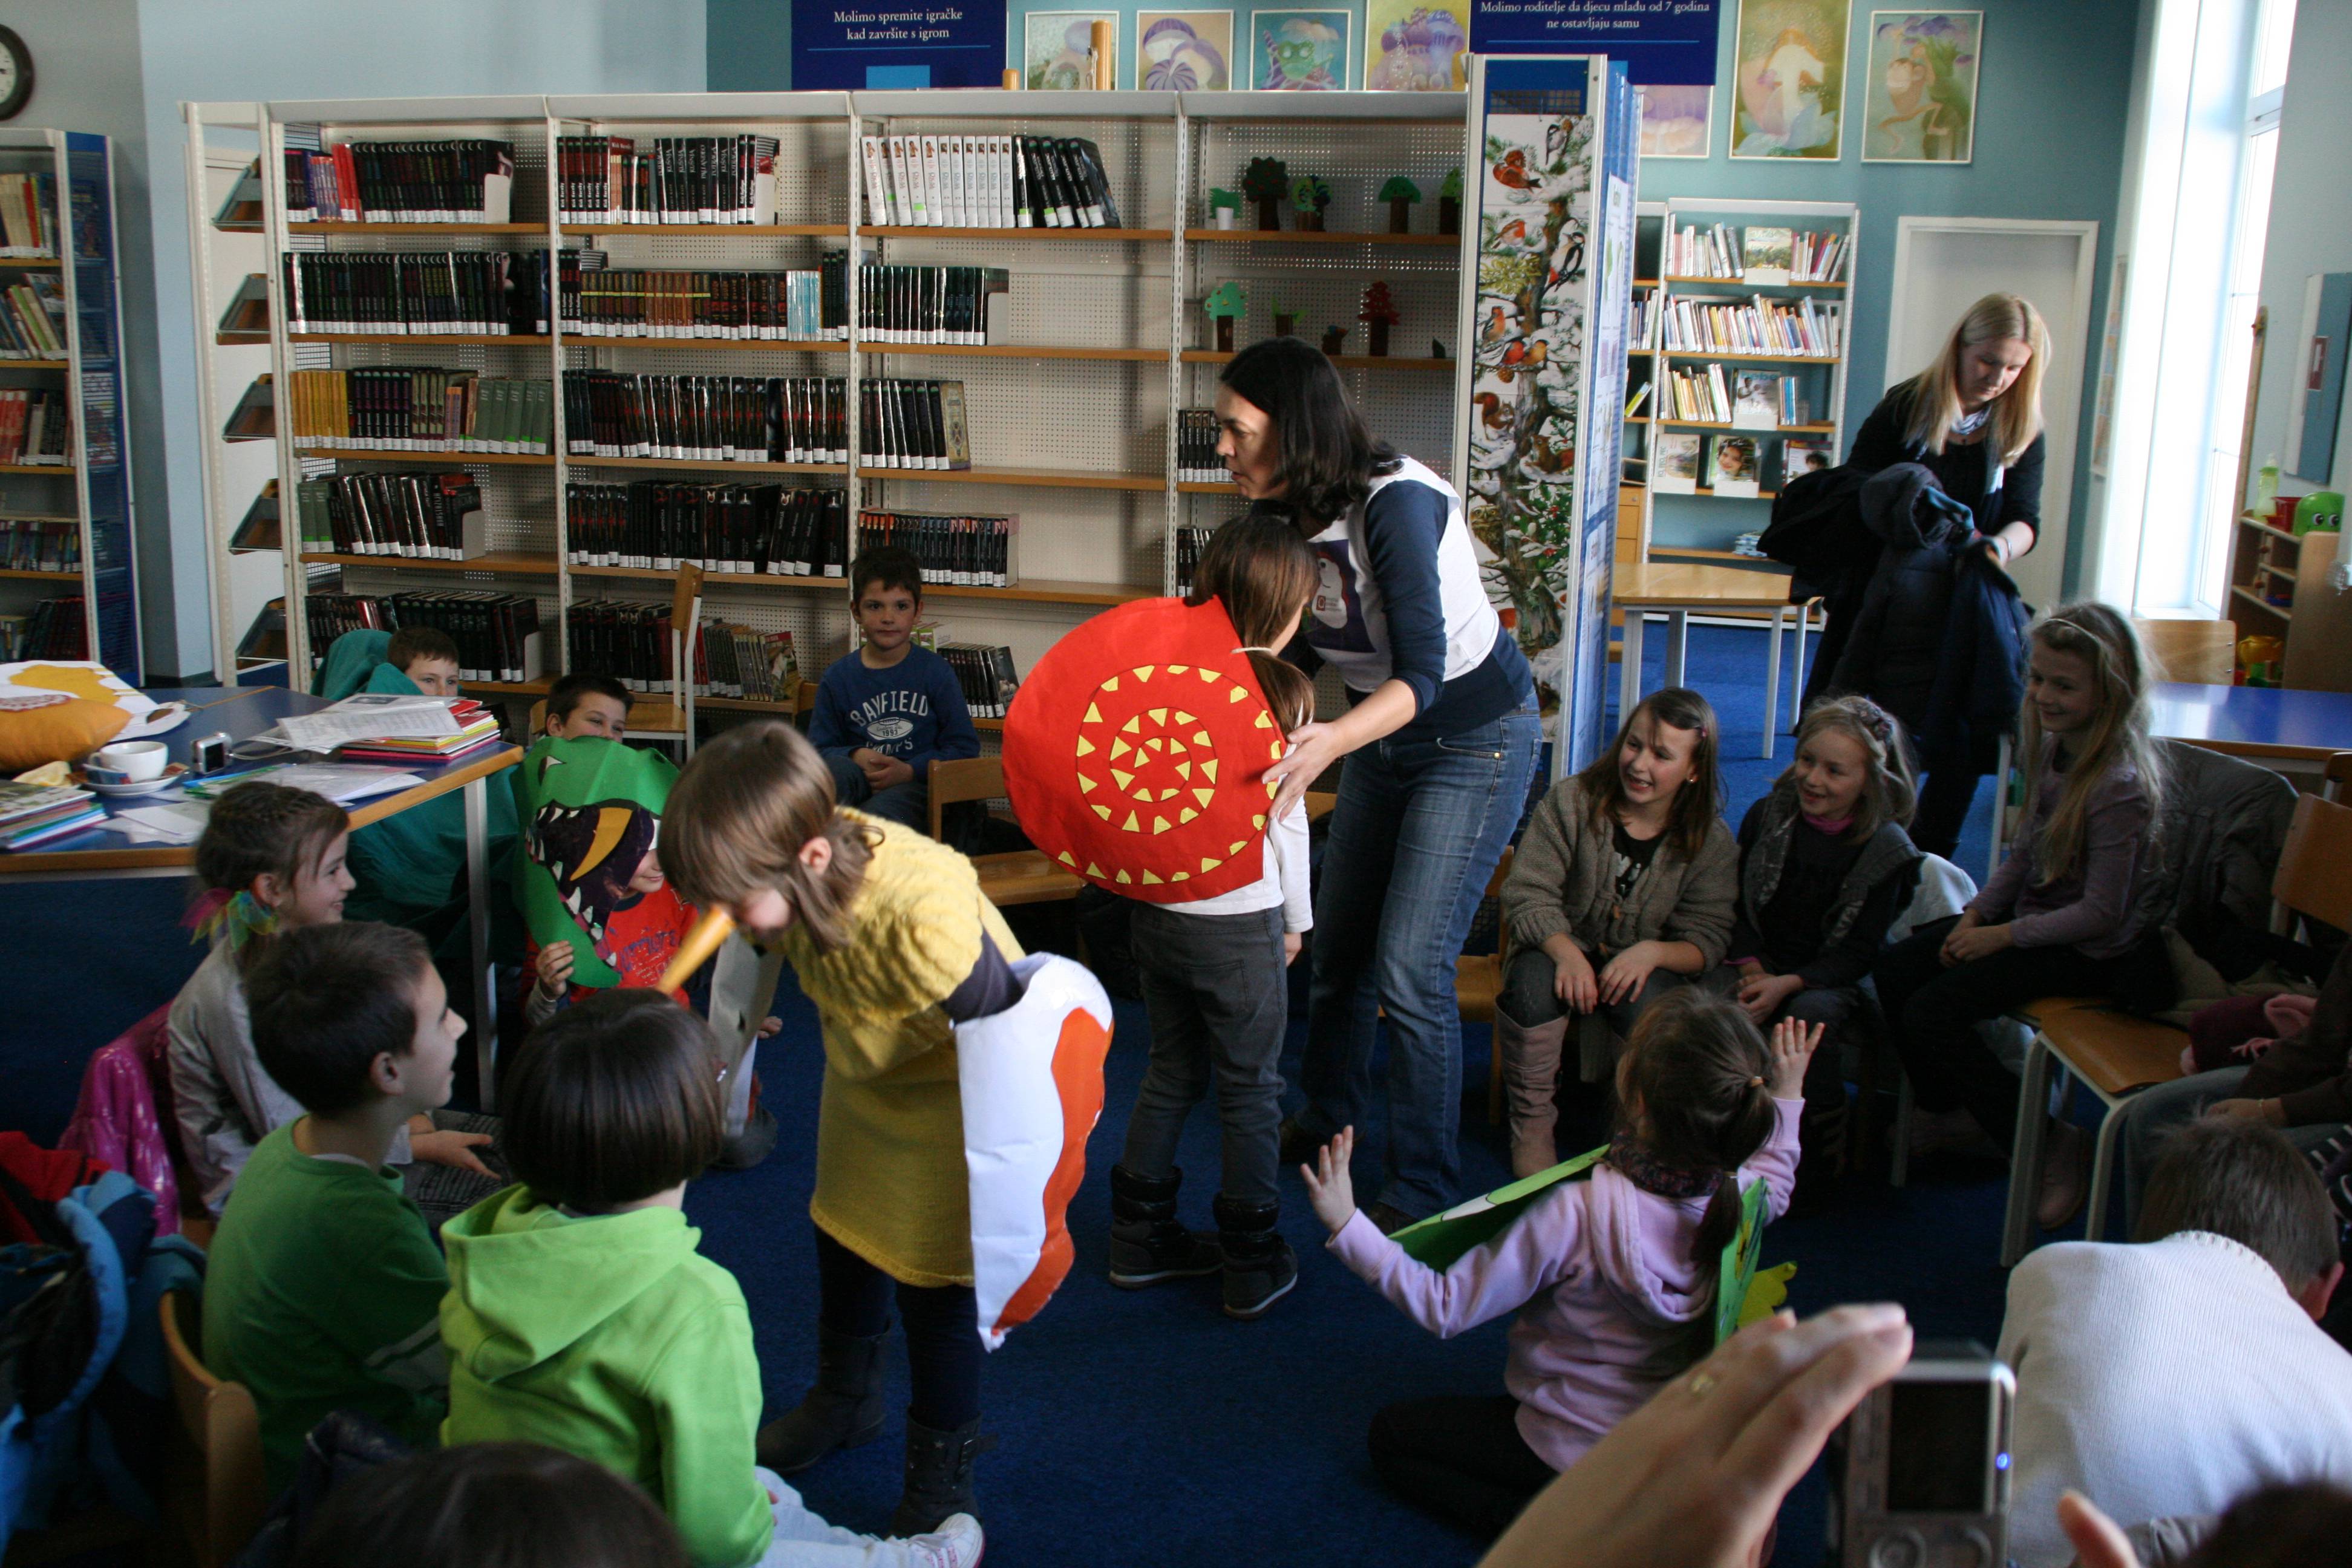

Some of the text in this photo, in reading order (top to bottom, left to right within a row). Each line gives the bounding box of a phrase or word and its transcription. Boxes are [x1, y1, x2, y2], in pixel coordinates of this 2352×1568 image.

[1480, 1, 1521, 12] Molimo
[1524, 1, 1566, 14] roditelje
[1569, 1, 1581, 11] da
[1583, 1, 1611, 14] djecu
[1649, 1, 1664, 11] od
[1665, 1, 1673, 11] 7
[1674, 1, 1710, 13] godina
[834, 8, 963, 24] Molimo spremite igračke
[1562, 18, 1610, 30] ostavljaju
[847, 28, 866, 40] kad
[869, 27, 908, 39] završite
[919, 27, 950, 41] igrom
[850, 691, 929, 727] BAYFIELD
